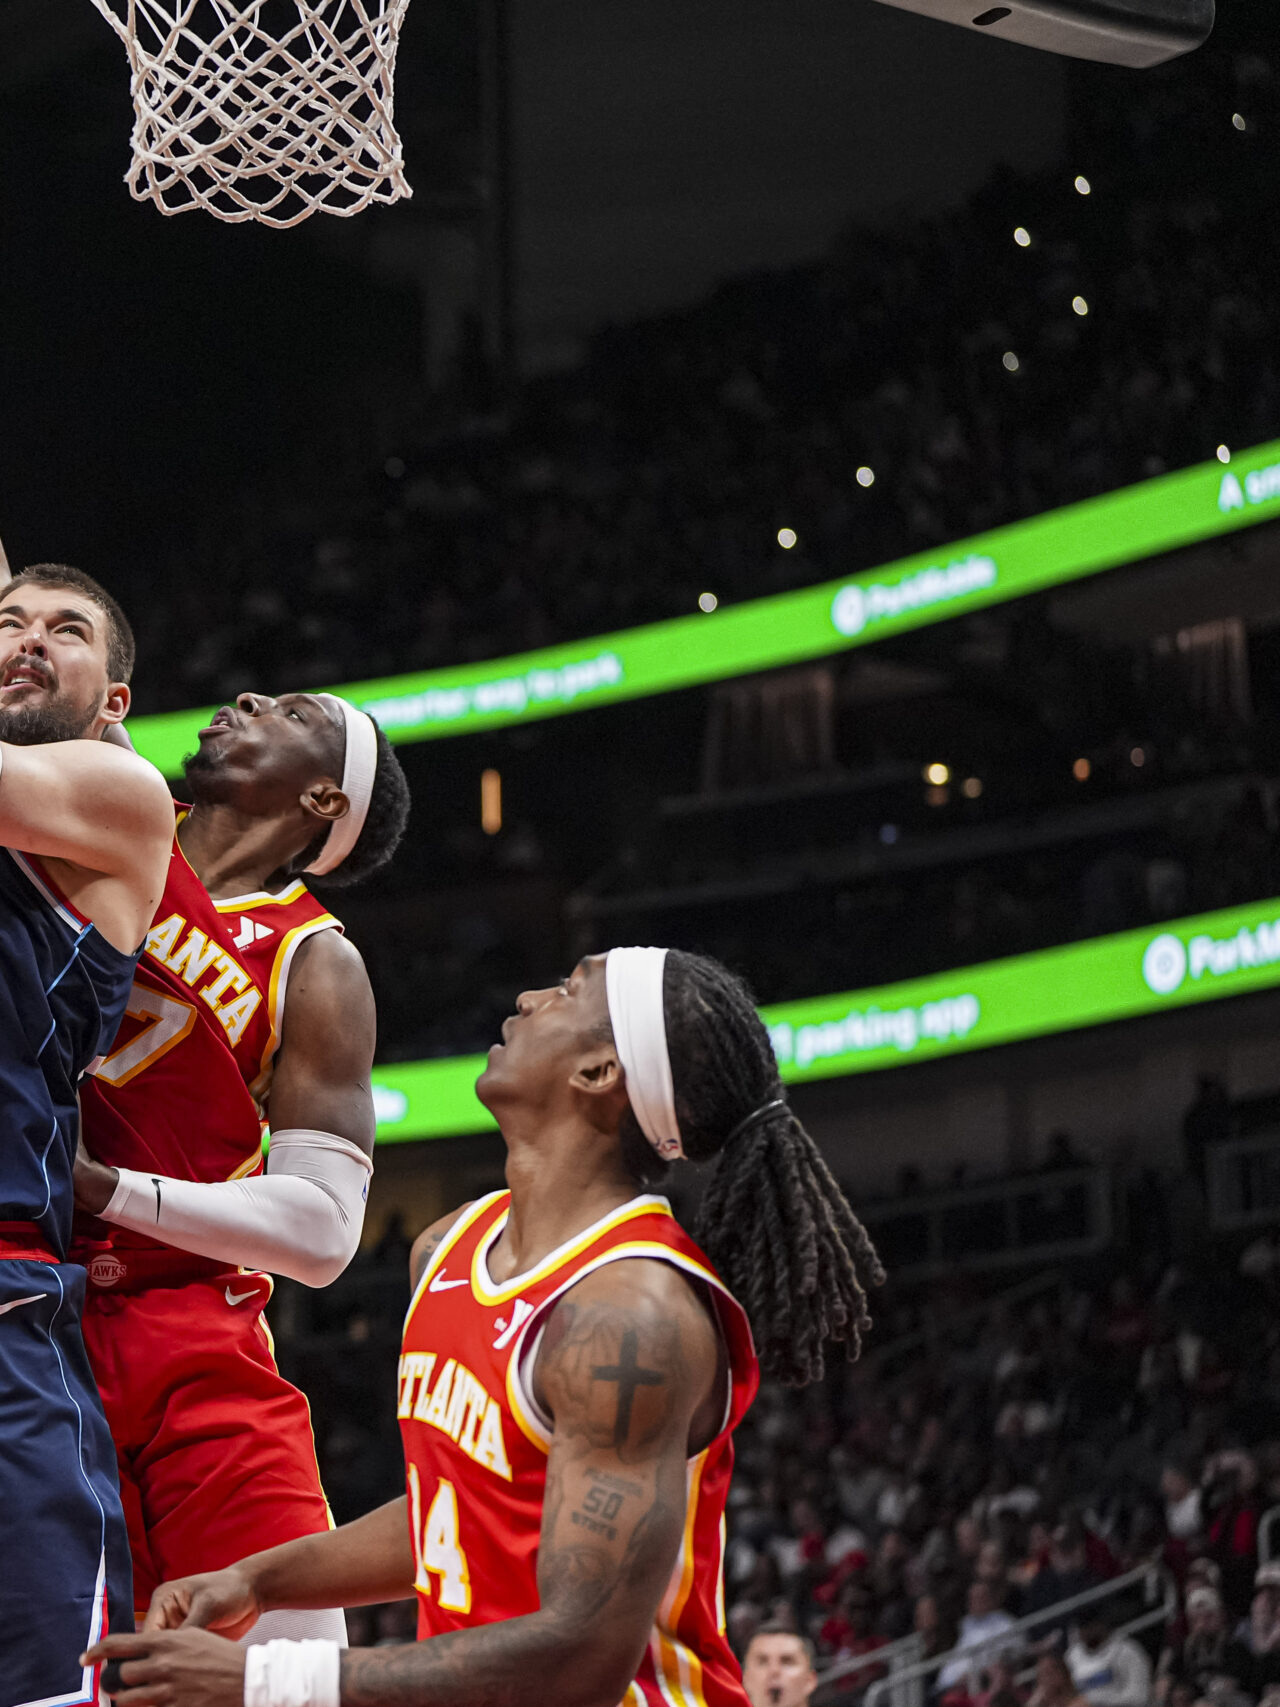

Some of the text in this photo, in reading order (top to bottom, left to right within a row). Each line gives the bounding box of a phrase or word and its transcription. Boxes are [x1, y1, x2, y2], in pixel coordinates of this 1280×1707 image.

[1219, 472, 1245, 512] A
[144, 913, 263, 1049] ANTA
[397, 1352, 513, 1483] TLANTA
[408, 1462, 472, 1615] 14
[582, 1486, 625, 1520] 50
